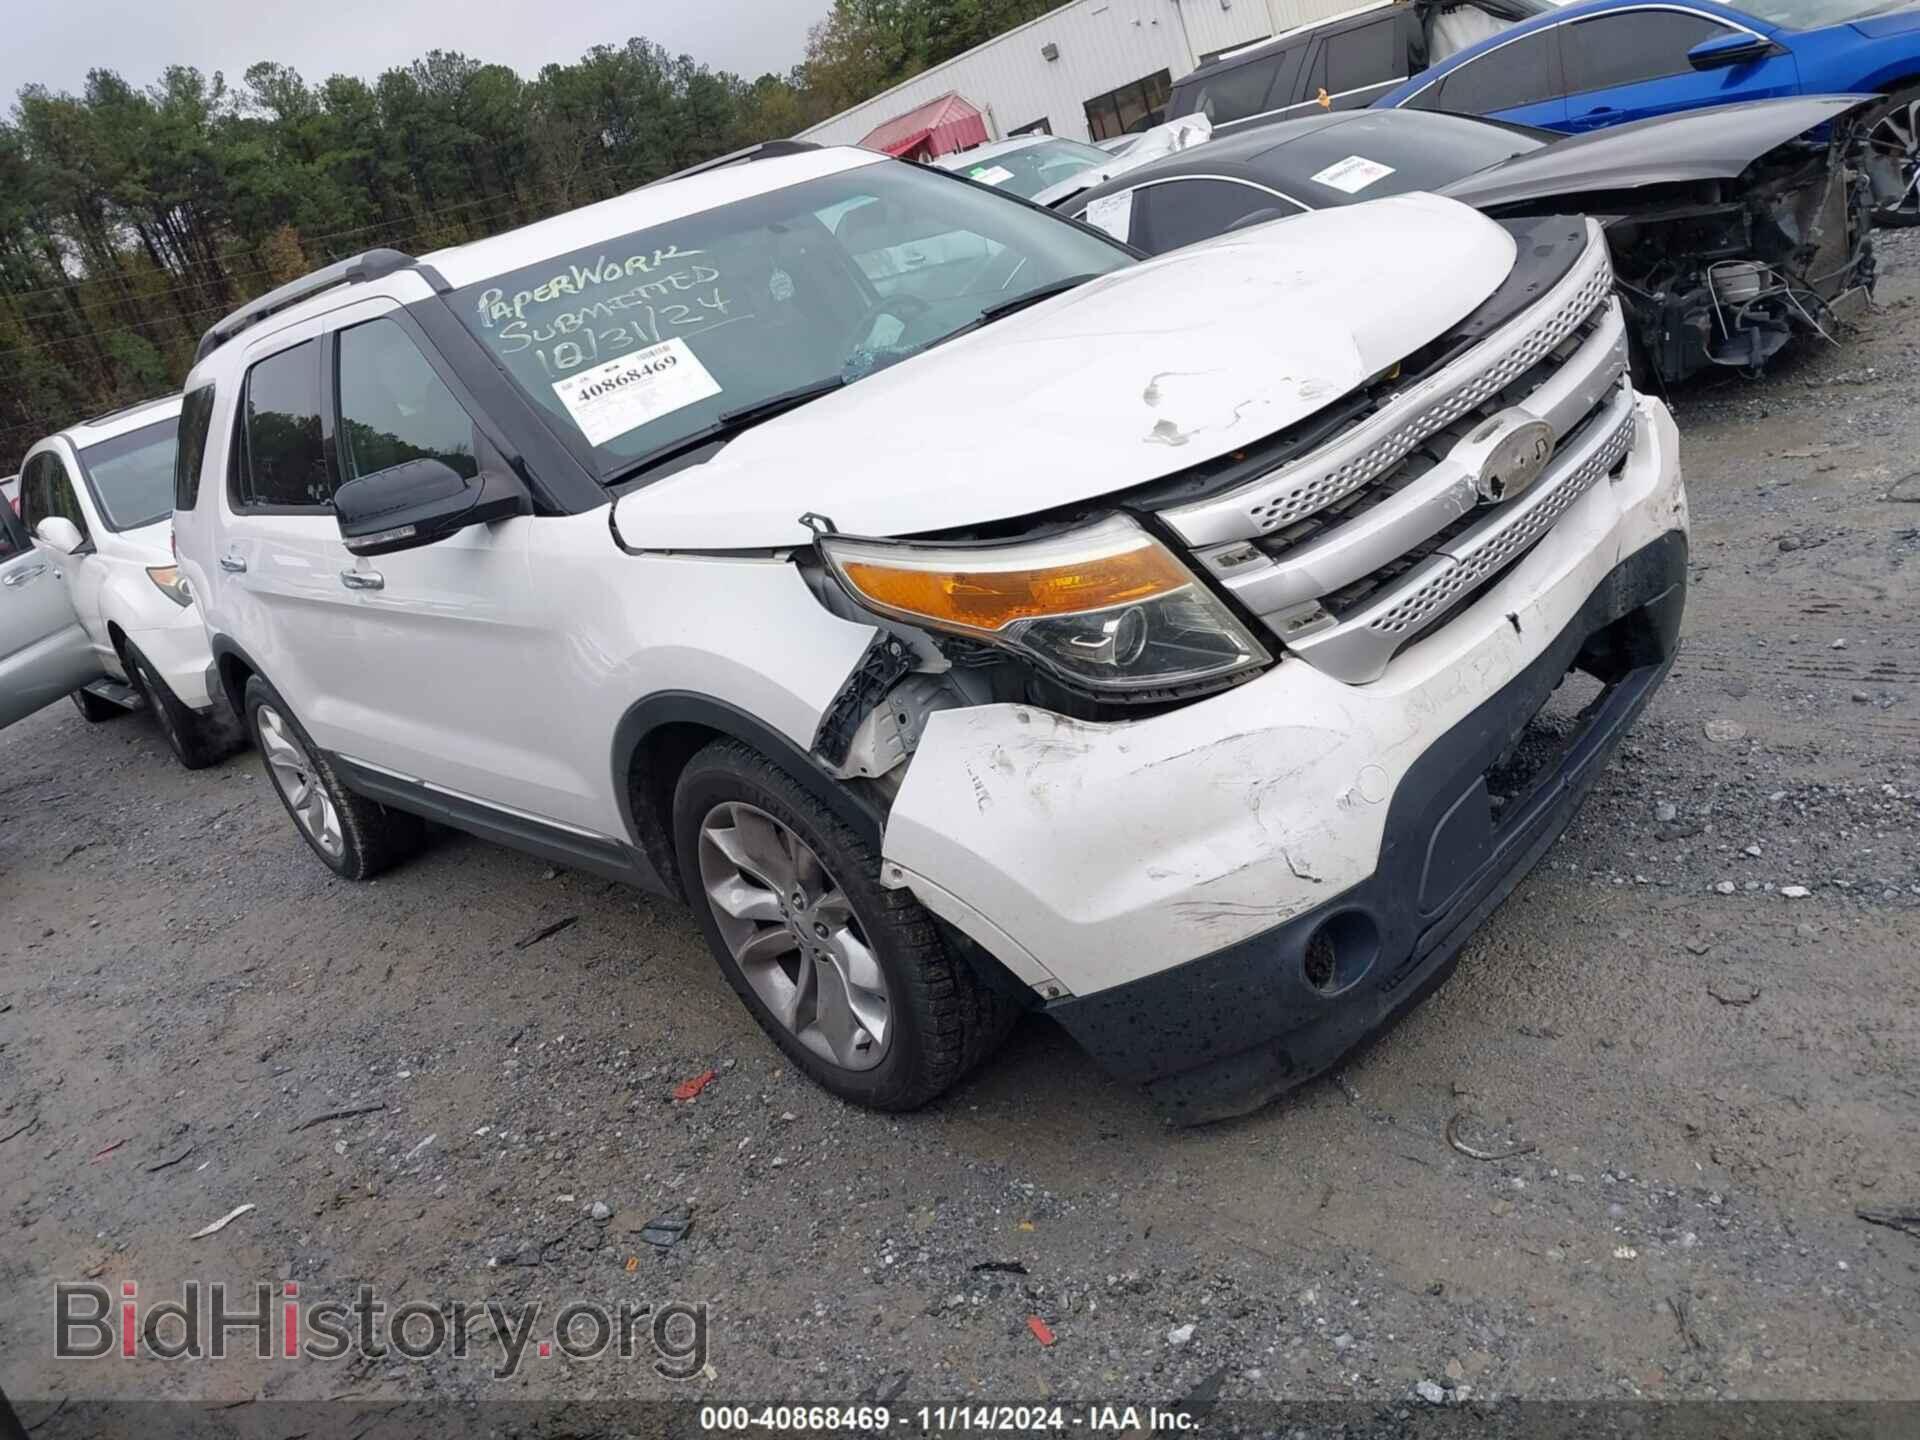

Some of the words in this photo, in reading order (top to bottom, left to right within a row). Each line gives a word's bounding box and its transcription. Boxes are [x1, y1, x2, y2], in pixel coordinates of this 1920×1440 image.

[499, 265, 719, 354] SUBMITTED
[535, 287, 732, 378] 10/31/24
[577, 354, 678, 402] 40868469
